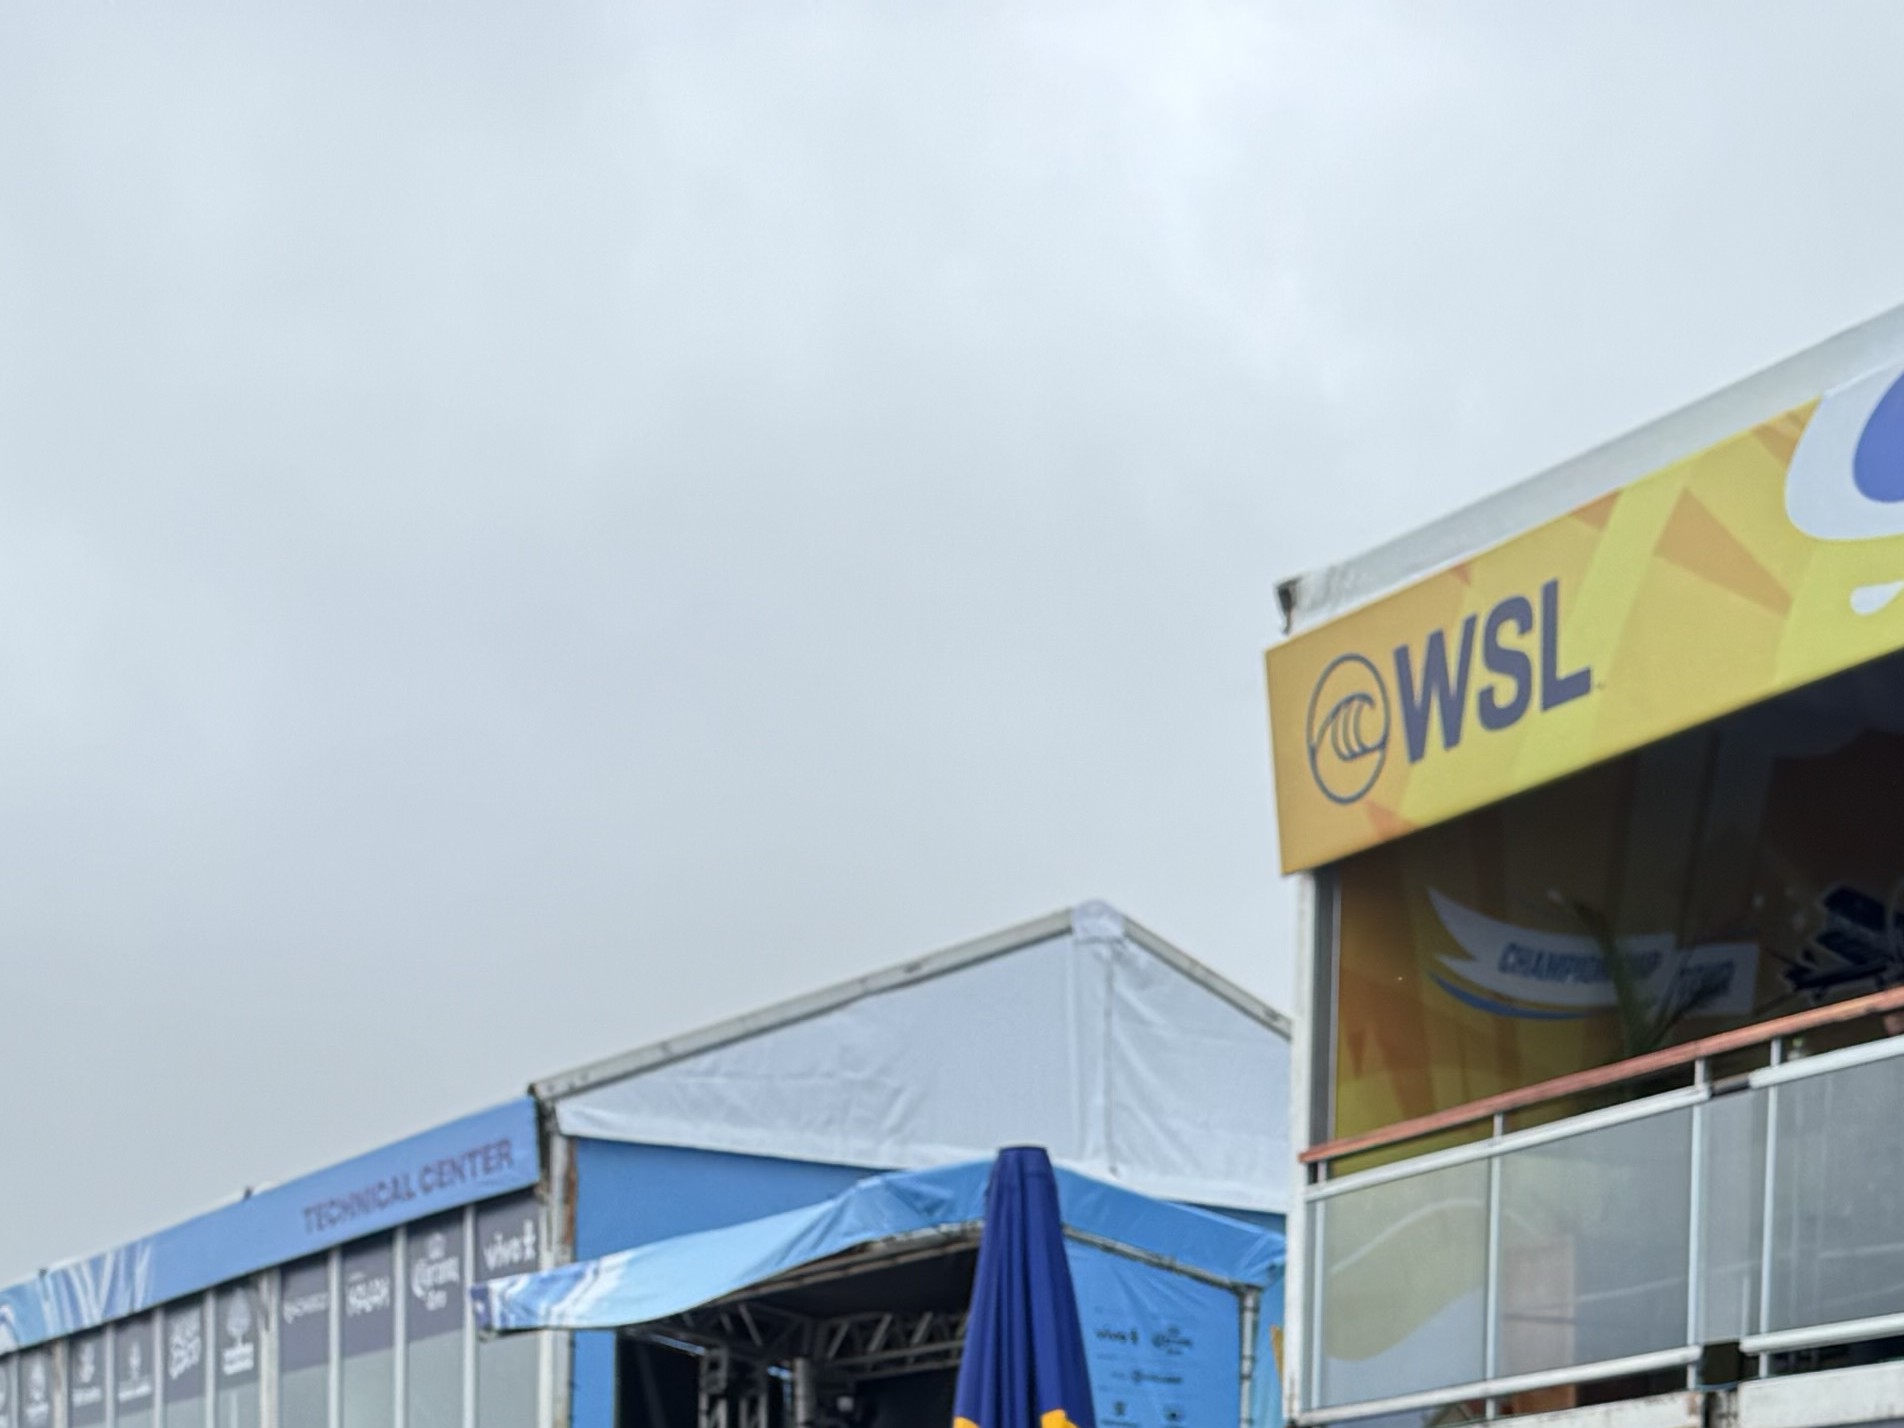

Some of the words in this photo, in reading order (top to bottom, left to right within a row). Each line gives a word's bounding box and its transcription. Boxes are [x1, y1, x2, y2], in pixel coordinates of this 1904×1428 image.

[1393, 578, 1592, 764] WSL
[302, 1172, 416, 1236] TECHNICAL
[417, 1137, 515, 1195] CENTER
